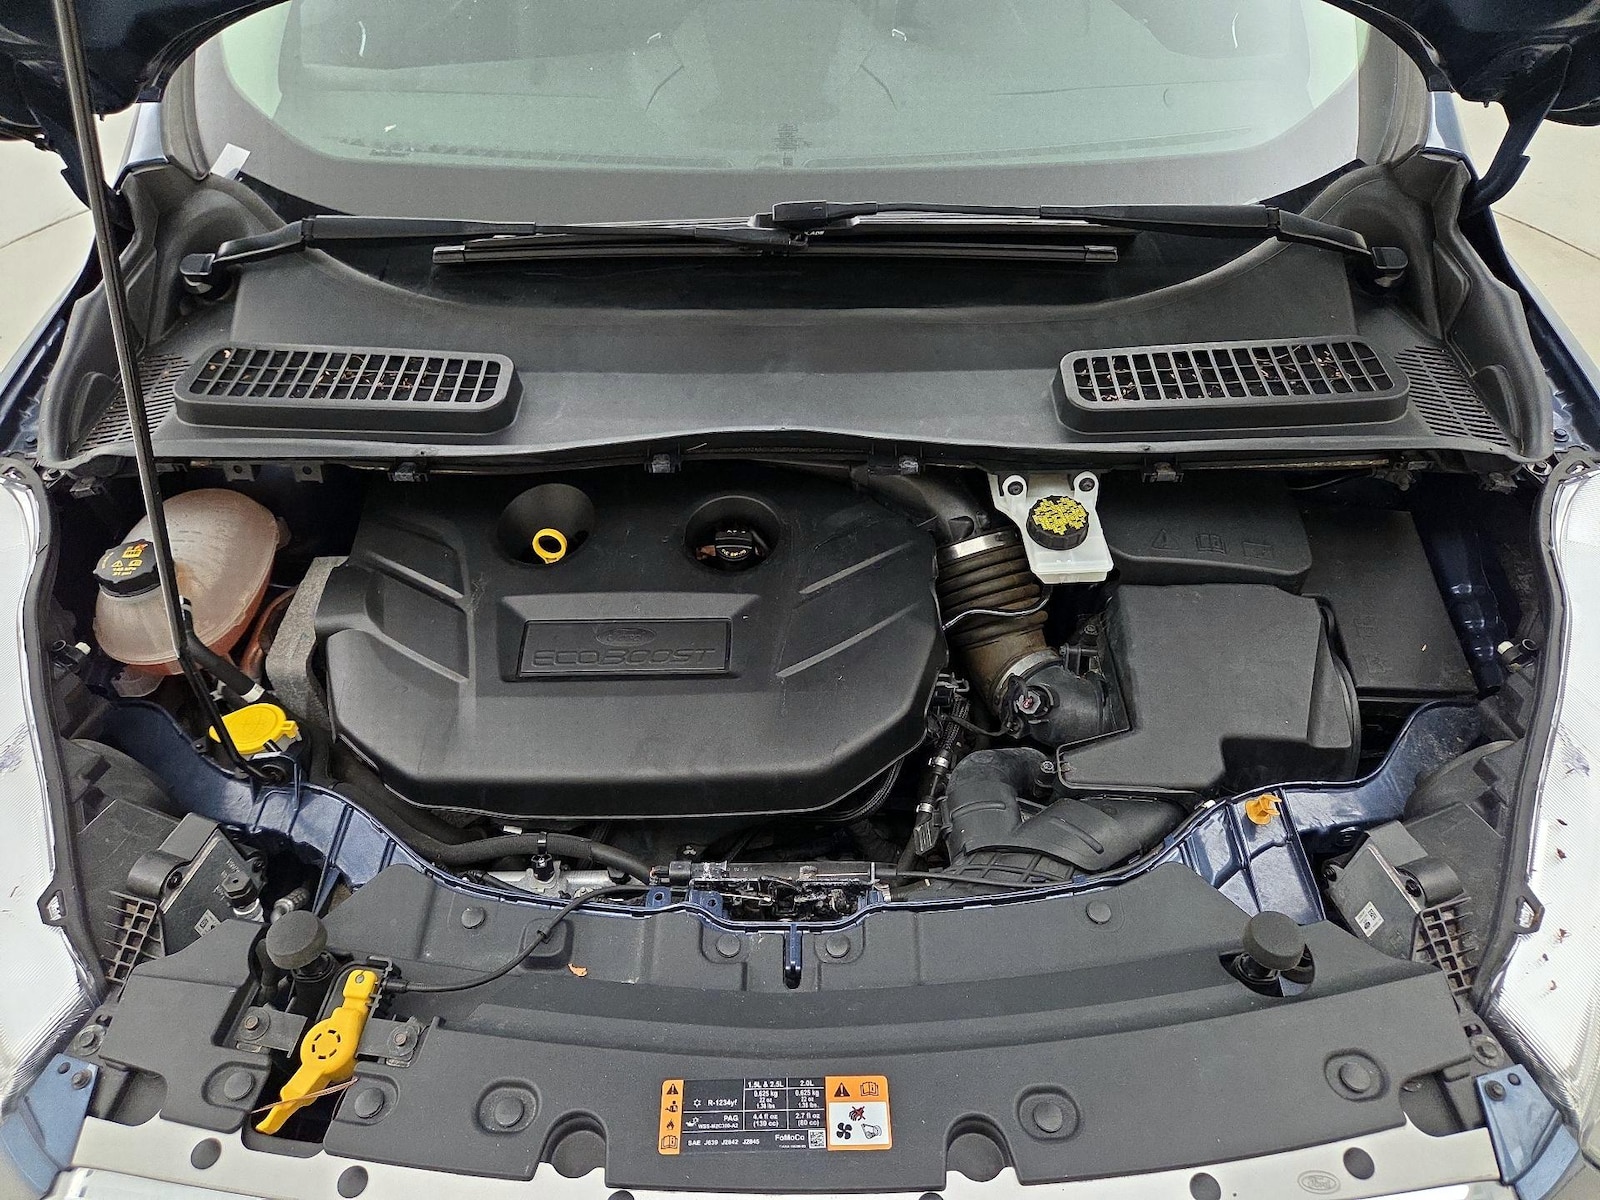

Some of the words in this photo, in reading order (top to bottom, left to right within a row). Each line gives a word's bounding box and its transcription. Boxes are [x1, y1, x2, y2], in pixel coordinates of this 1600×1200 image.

[532, 648, 716, 668] ECOBOOST
[771, 1090, 779, 1098] kg
[812, 1089, 820, 1097] kg
[707, 1099, 738, 1107] R-1234yf
[809, 1119, 820, 1127] cc)
